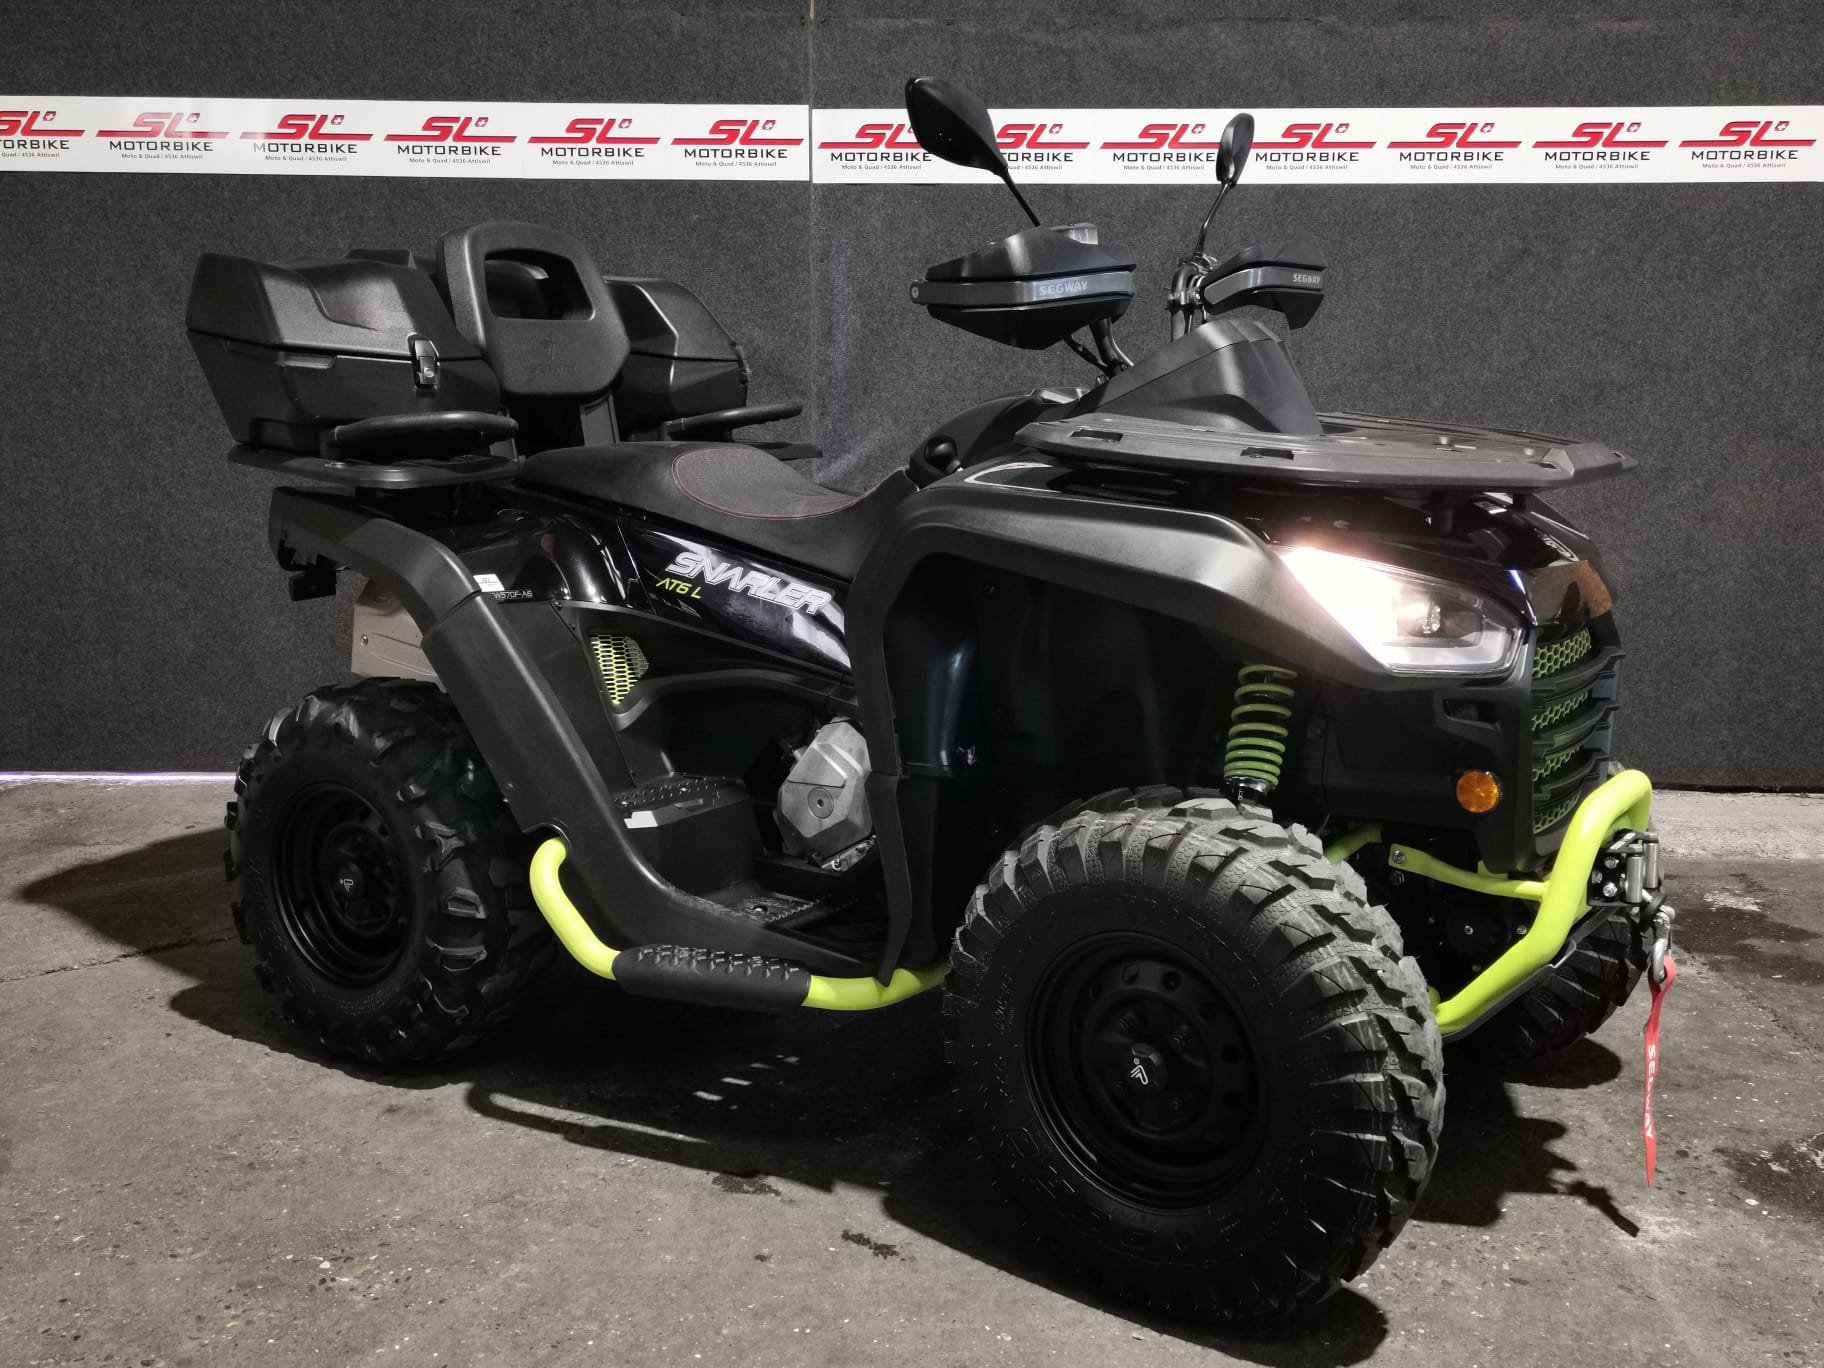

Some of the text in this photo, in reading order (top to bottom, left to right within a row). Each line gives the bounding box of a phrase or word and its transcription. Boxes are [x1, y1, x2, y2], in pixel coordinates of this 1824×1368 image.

[110, 141, 214, 151] MOTORBIKE
[253, 142, 358, 153] MOTORBIKE
[397, 145, 502, 156] MOTORBIKE
[541, 147, 645, 157] MOTORBIKE
[684, 148, 787, 159] MOTORBIKE
[831, 152, 932, 162] MOTORBIKE
[1113, 152, 1216, 162] MOTORBIKE
[1255, 152, 1359, 161] MOTORBIKE
[1399, 152, 1504, 161] MOTORBIKE
[1544, 151, 1650, 161] MOTORBIKE
[1692, 150, 1798, 160] MOTORBIKE
[1292, 273, 1321, 284] SEGWAY
[1040, 281, 1088, 296] SEGWAY
[656, 578, 702, 599] AT6 L
[665, 552, 832, 615] SNARLER
[1645, 1044, 1656, 1138] SEGWAY
